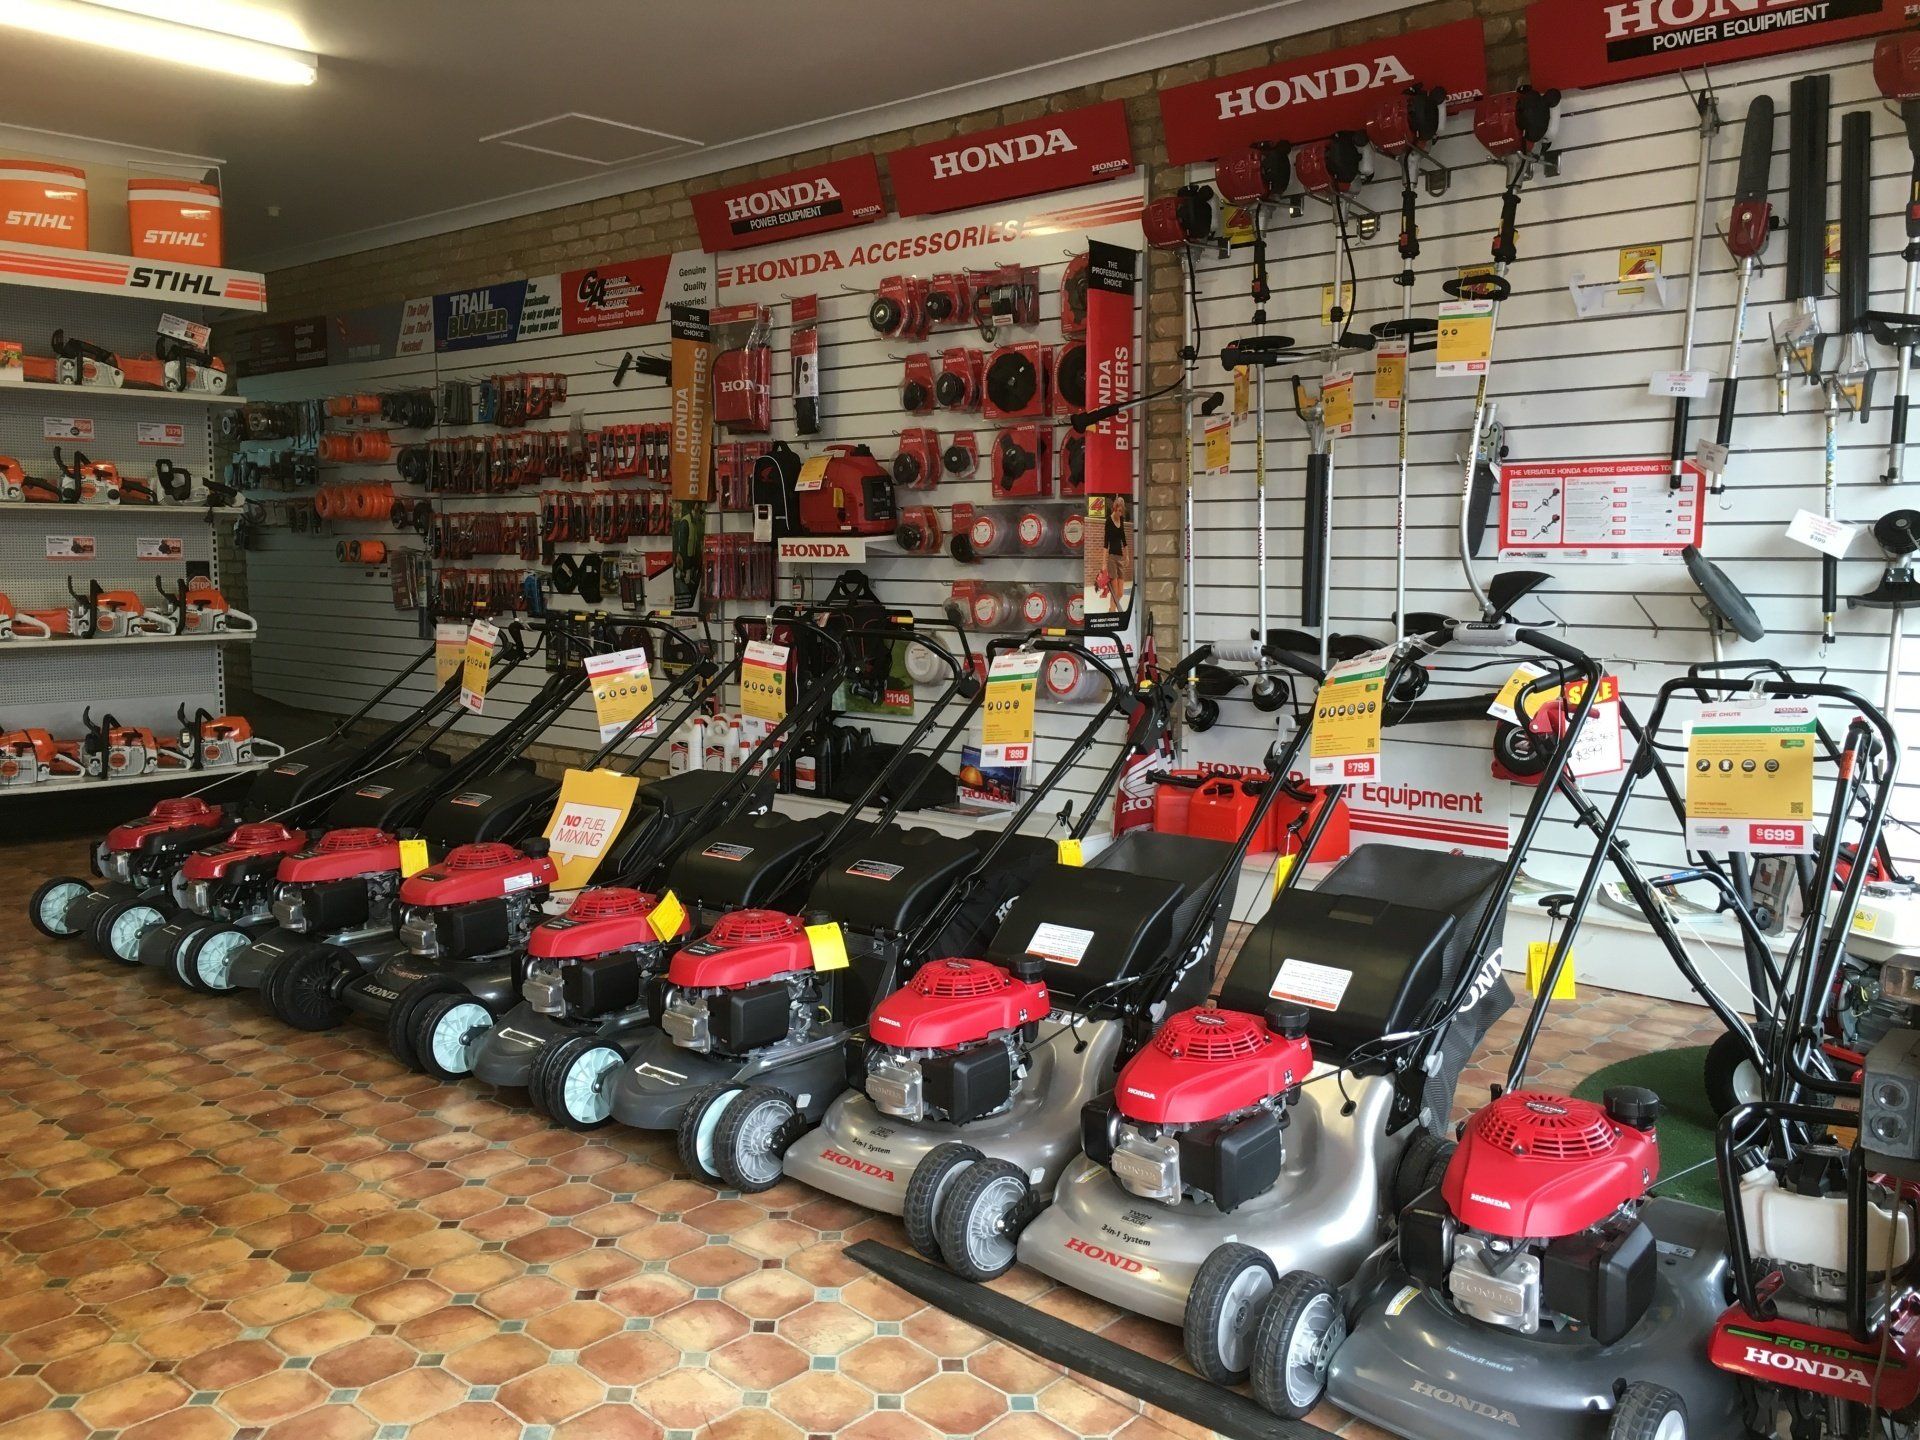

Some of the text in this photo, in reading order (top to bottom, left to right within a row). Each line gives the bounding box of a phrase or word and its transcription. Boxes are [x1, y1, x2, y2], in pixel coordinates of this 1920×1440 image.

[1604, 0, 1799, 38] HON
[1653, 3, 1830, 50] POWER EQUIPMENT
[1215, 54, 1414, 120] HONDA
[1446, 89, 1483, 101] ONDA
[1489, 137, 1514, 147] HONDA
[930, 128, 1077, 180] HONDA
[1092, 158, 1128, 172] HONDA
[725, 177, 840, 221] HONDA
[750, 205, 822, 230] POWER EQUIPMENT
[852, 204, 881, 216] HONDA
[5, 211, 72, 230] STIHL
[143, 230, 205, 247] STIHL
[735, 218, 1020, 287] HONDA ACCESSORIES
[679, 266, 707, 277] Genuine
[1107, 260, 1118, 270] THE
[1091, 266, 1134, 281] PROFESSIONAL'S
[130, 267, 221, 297] STIHL
[683, 281, 707, 292] Quality
[882, 285, 902, 293] HONDA
[1103, 277, 1123, 288] CHOICE
[450, 290, 493, 316] TRAIL
[664, 296, 707, 310] Accessories!
[448, 308, 509, 340] BLAZER
[577, 316, 597, 325] Proudly
[598, 311, 624, 321] Australian
[625, 309, 644, 318] Owned
[672, 319, 709, 331] PROFESSIONA
[688, 314, 700, 322] THE
[683, 329, 704, 338] CHOICE
[1014, 344, 1038, 352] HONDA
[1099, 359, 1112, 434] HNDA
[1115, 346, 1129, 450] BLOWERS
[676, 387, 689, 453] HONDA
[688, 347, 708, 495] BRUSHCUTTERS
[1523, 467, 1555, 476] VERSATILE
[1557, 467, 1581, 475] HONDA
[1582, 465, 1615, 475] 4-STROKE
[1616, 465, 1659, 473] GARDENING
[781, 544, 850, 557] HONDA
[1090, 643, 1133, 654] HONA
[886, 692, 910, 705] $1149
[1347, 762, 1370, 773] $799
[1362, 782, 1483, 813] Equipment
[563, 815, 606, 831] NO FUEL
[555, 828, 603, 847] MIXING
[1756, 828, 1796, 842] $699
[363, 984, 399, 1000] HOND
[879, 1016, 901, 1028] HONDA
[1127, 1087, 1156, 1100] HONDA
[852, 1137, 891, 1155] 3-in-1 System
[820, 1148, 896, 1182] HONDA
[1470, 1193, 1512, 1210] HONDA
[1130, 1209, 1153, 1220] TWIN
[1101, 1224, 1151, 1247] 3-in-1 System
[1744, 1346, 1871, 1388] HONDA
[1410, 1379, 1521, 1428] HONDA
